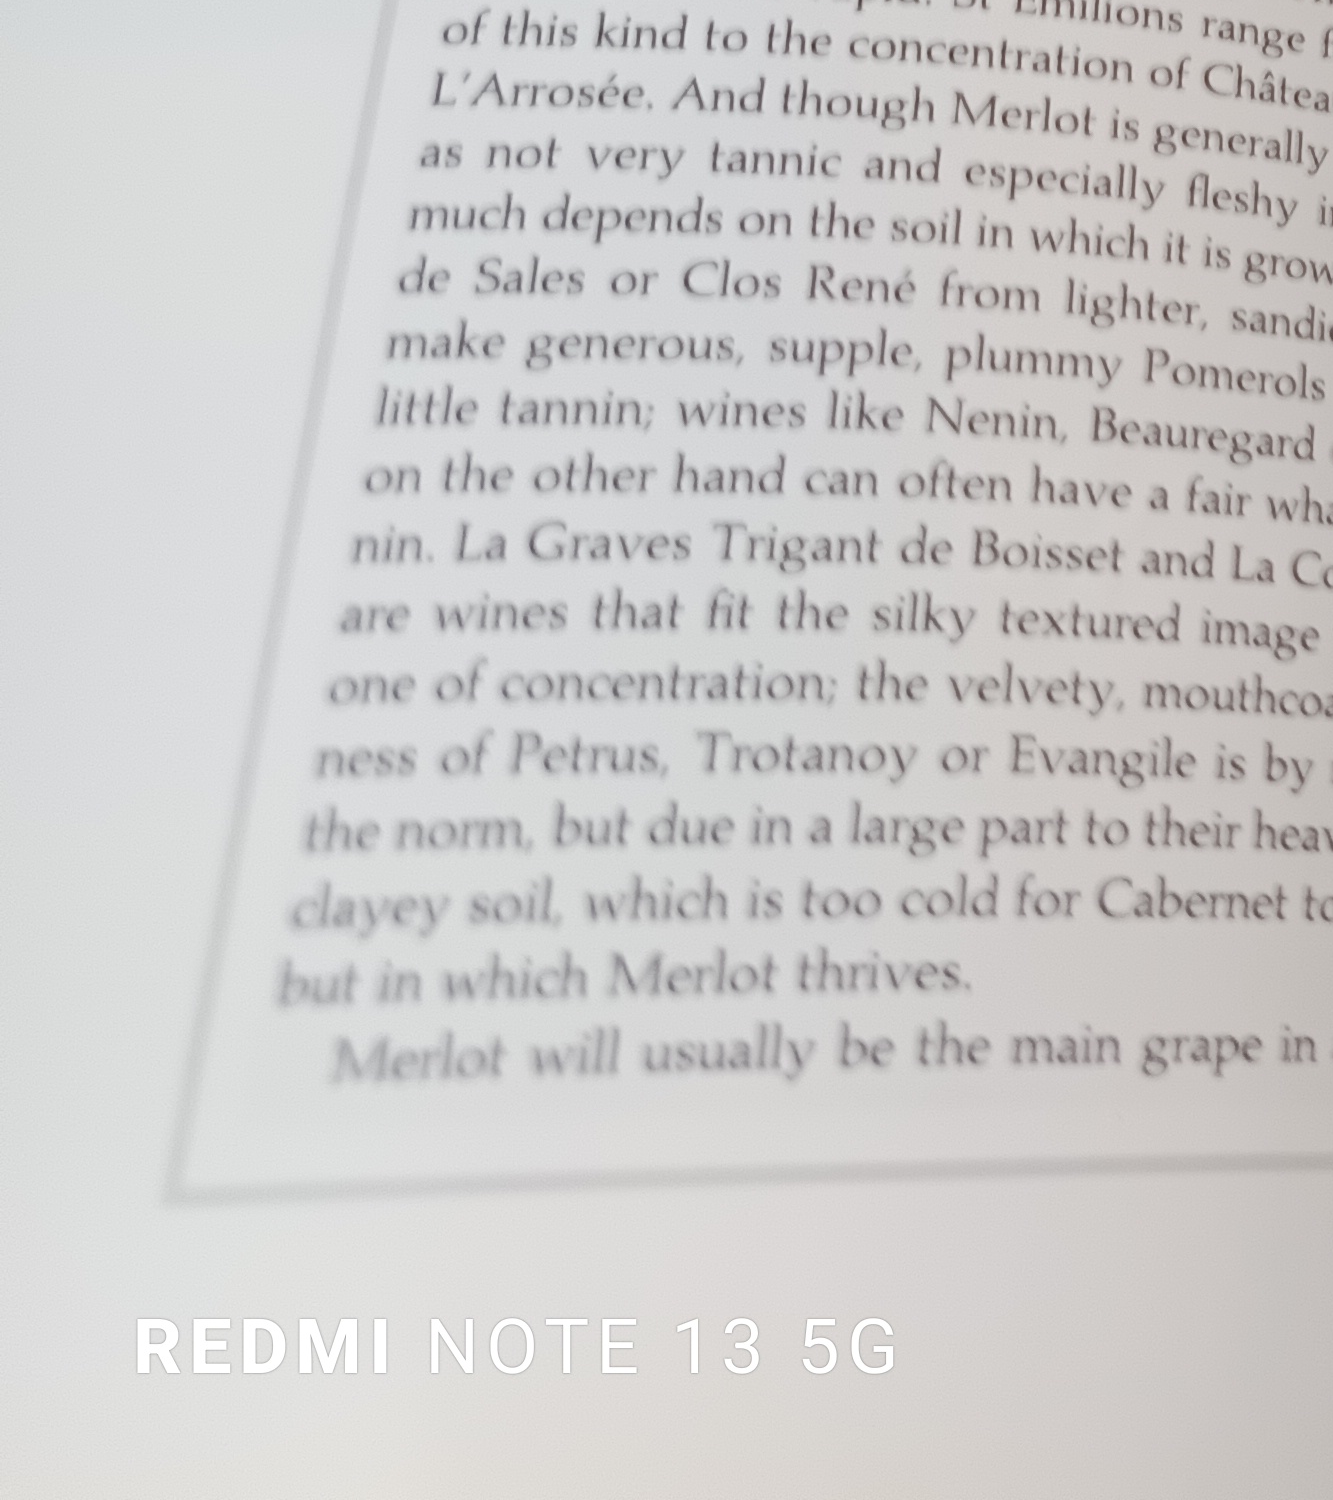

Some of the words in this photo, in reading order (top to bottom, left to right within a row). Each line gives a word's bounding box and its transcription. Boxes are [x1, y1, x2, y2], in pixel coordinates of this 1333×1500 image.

[376, 383, 479, 426] little
[500, 390, 655, 430] tannin;
[677, 391, 806, 429] wines
[827, 388, 905, 432] like
[925, 395, 1068, 444] Nenin,
[1091, 405, 1316, 466] Beauregard
[316, 749, 416, 778] ness
[439, 728, 494, 776] of
[509, 731, 668, 777] Petrus,
[696, 729, 919, 786] Trotanoy
[938, 744, 990, 775] or
[1009, 732, 1198, 790] Evangile
[1215, 743, 1247, 782] is
[1264, 740, 1315, 796] by
